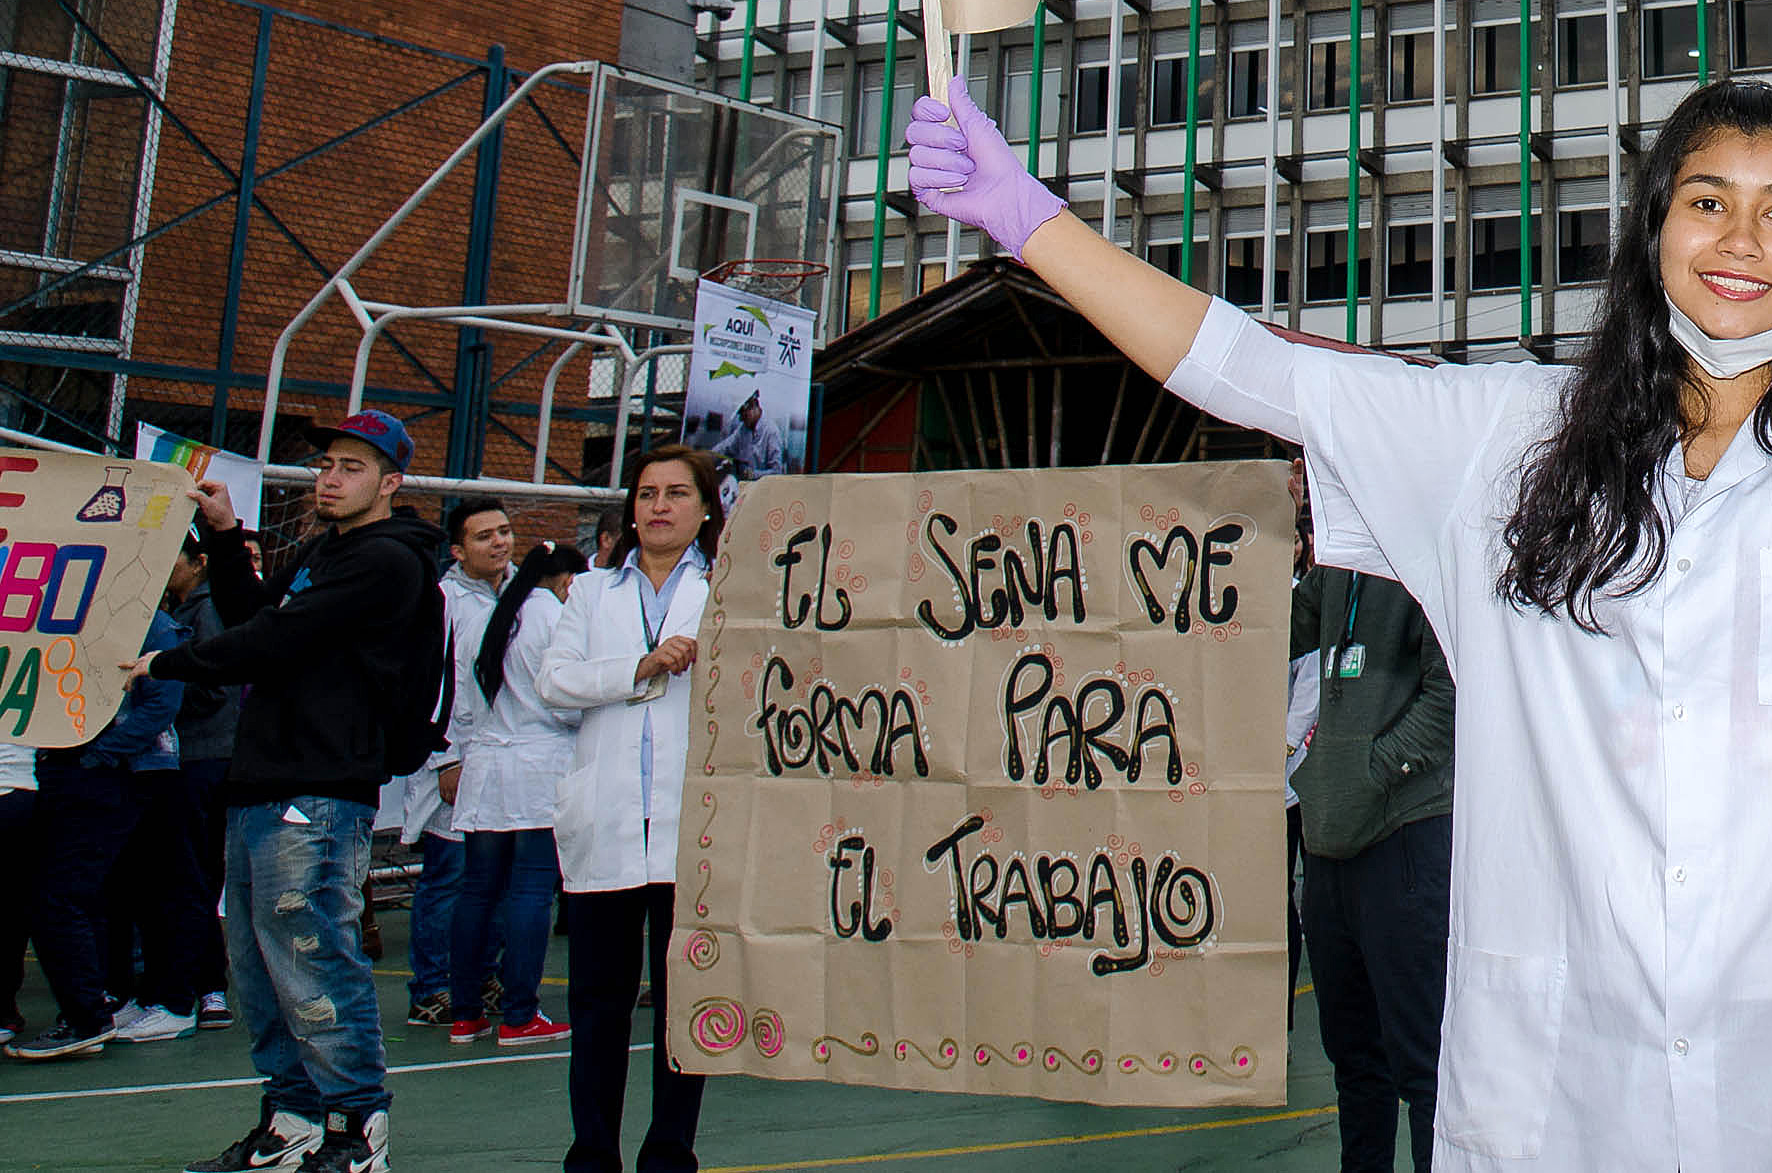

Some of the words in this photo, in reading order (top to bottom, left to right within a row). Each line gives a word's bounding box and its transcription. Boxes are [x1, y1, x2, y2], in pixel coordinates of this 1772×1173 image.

[725, 317, 755, 337] AQUÍ
[779, 333, 801, 345] SENA
[0, 542, 107, 634] BO
[775, 523, 852, 630] EL
[918, 511, 1086, 641] SENA
[1129, 523, 1244, 634] ME
[1005, 652, 1183, 790] PARA
[830, 836, 893, 942] EL
[924, 814, 1214, 976] TRABAJO
